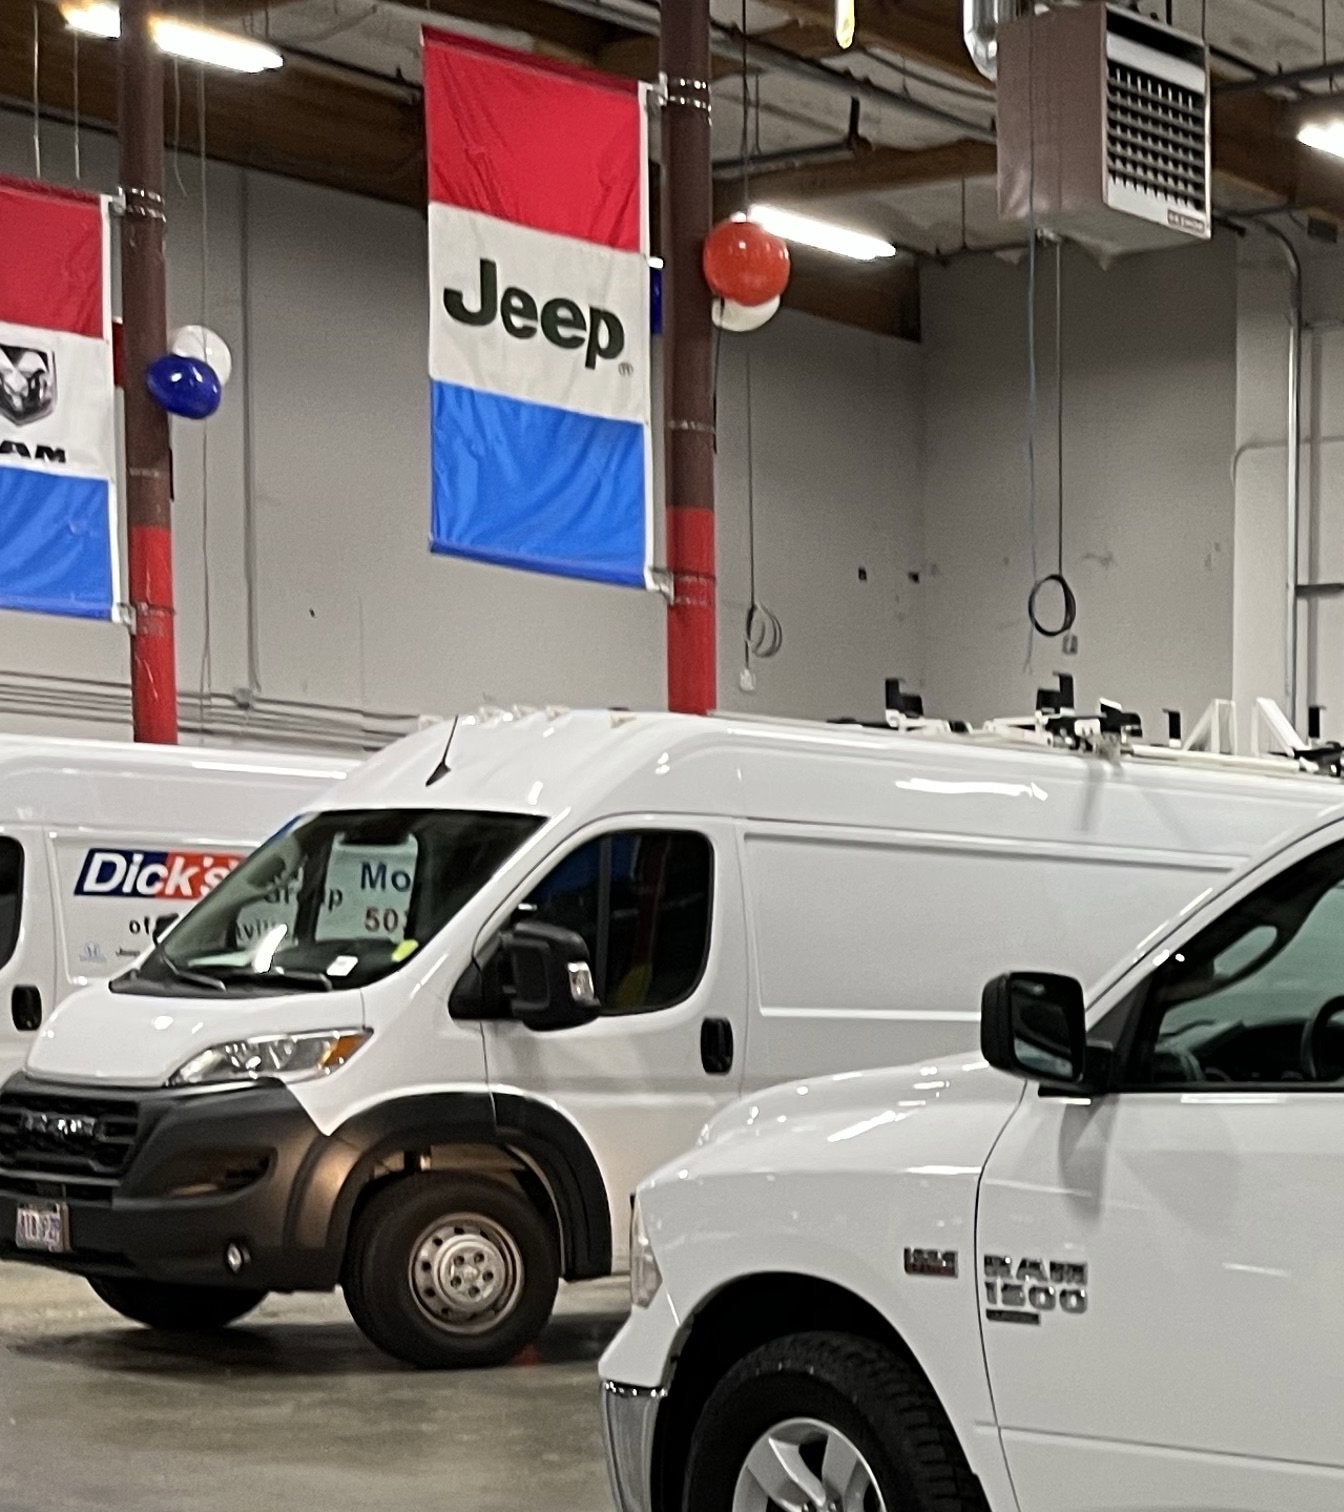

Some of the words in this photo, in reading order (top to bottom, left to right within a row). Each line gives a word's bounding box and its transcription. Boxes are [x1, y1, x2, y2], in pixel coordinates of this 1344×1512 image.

[443, 257, 625, 370] Jeep
[0, 440, 66, 463] AM
[365, 906, 409, 934] 50
[983, 1254, 1088, 1286] RAM
[984, 1281, 1088, 1315] 1500
